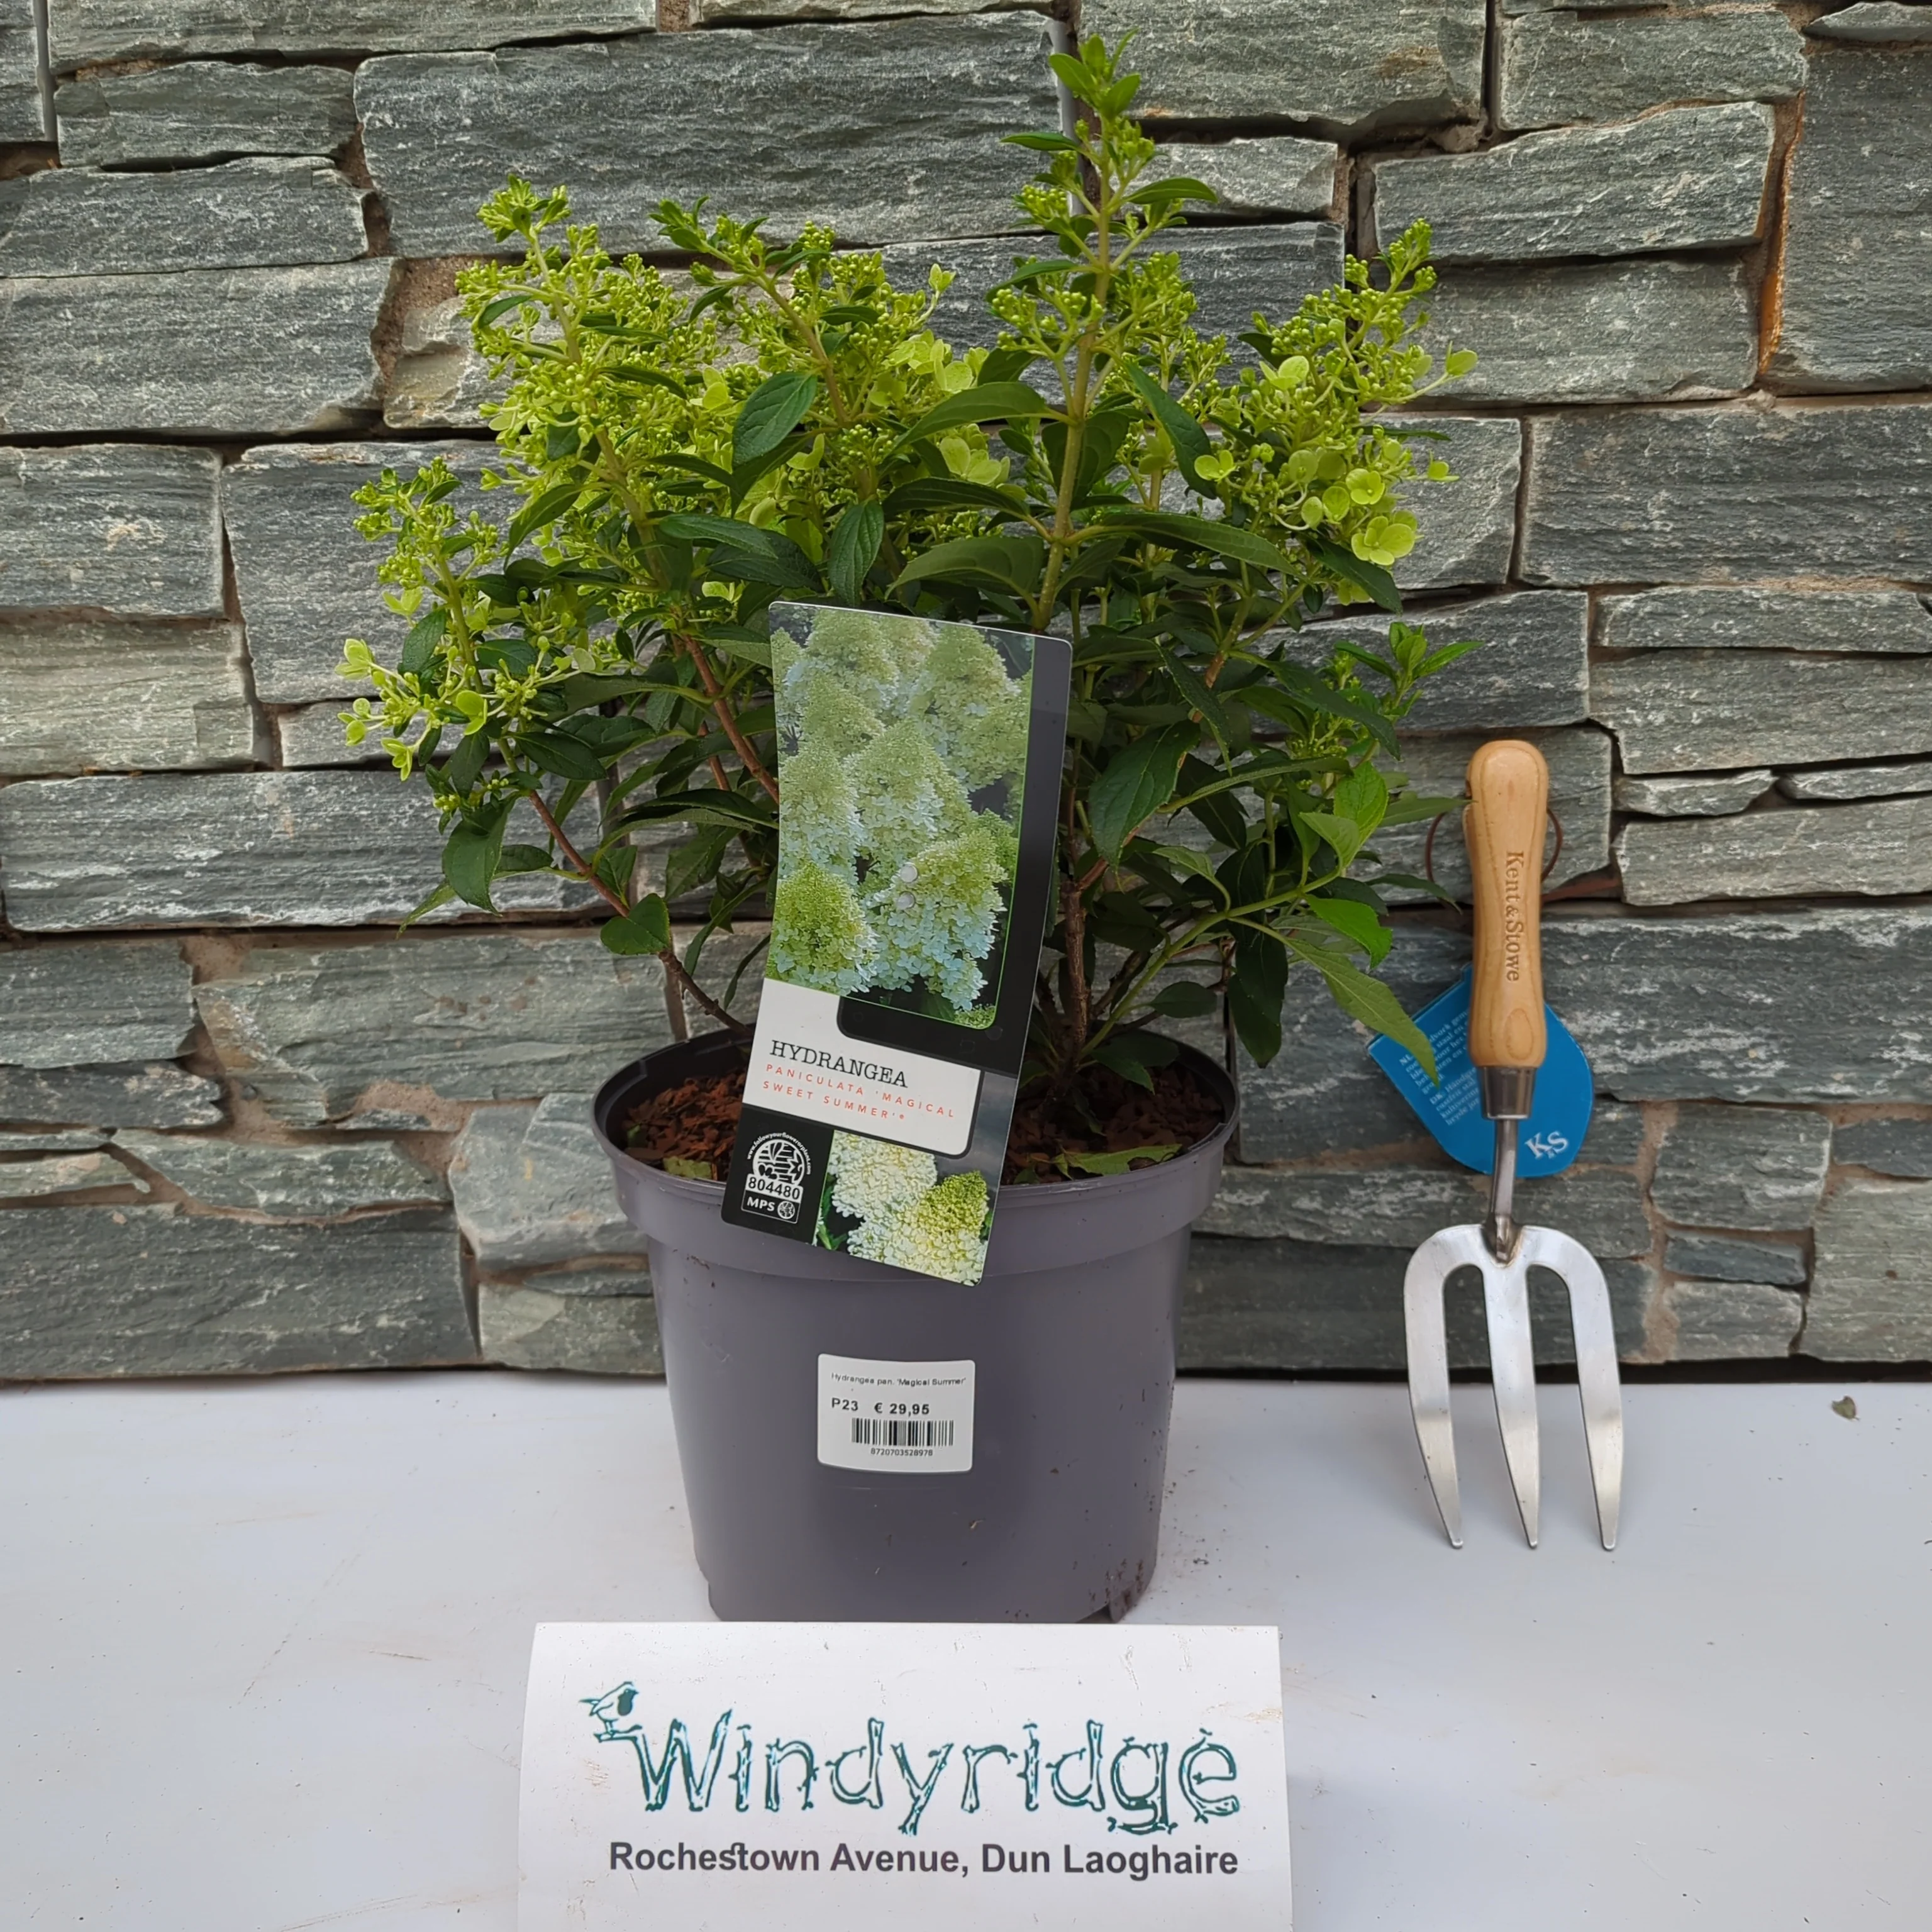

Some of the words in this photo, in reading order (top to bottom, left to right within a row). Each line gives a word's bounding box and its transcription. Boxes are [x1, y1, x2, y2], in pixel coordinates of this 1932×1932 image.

[1506, 851, 1524, 902] Kent
[1506, 920, 1524, 982] Stowe
[769, 1040, 909, 1088] HYDRANGEA
[763, 1080, 814, 1100] SWEET
[766, 1064, 864, 1096] PANICULATA
[748, 1177, 800, 1201] 804480
[747, 1196, 775, 1212] MPS
[831, 1372, 875, 1384] Hydrangea
[877, 1378, 895, 1386] pan.
[831, 1397, 859, 1411] P23
[874, 1402, 883, 1414] €
[889, 1402, 930, 1417] 29,95
[870, 1447, 934, 1457] 8720703528978
[595, 1709, 1240, 1836] Windyridge
[610, 1841, 819, 1871] Rochestown
[830, 1843, 968, 1878] Avenue,
[982, 1843, 1050, 1873] Dun
[1064, 1844, 1238, 1881] Laoghaire
